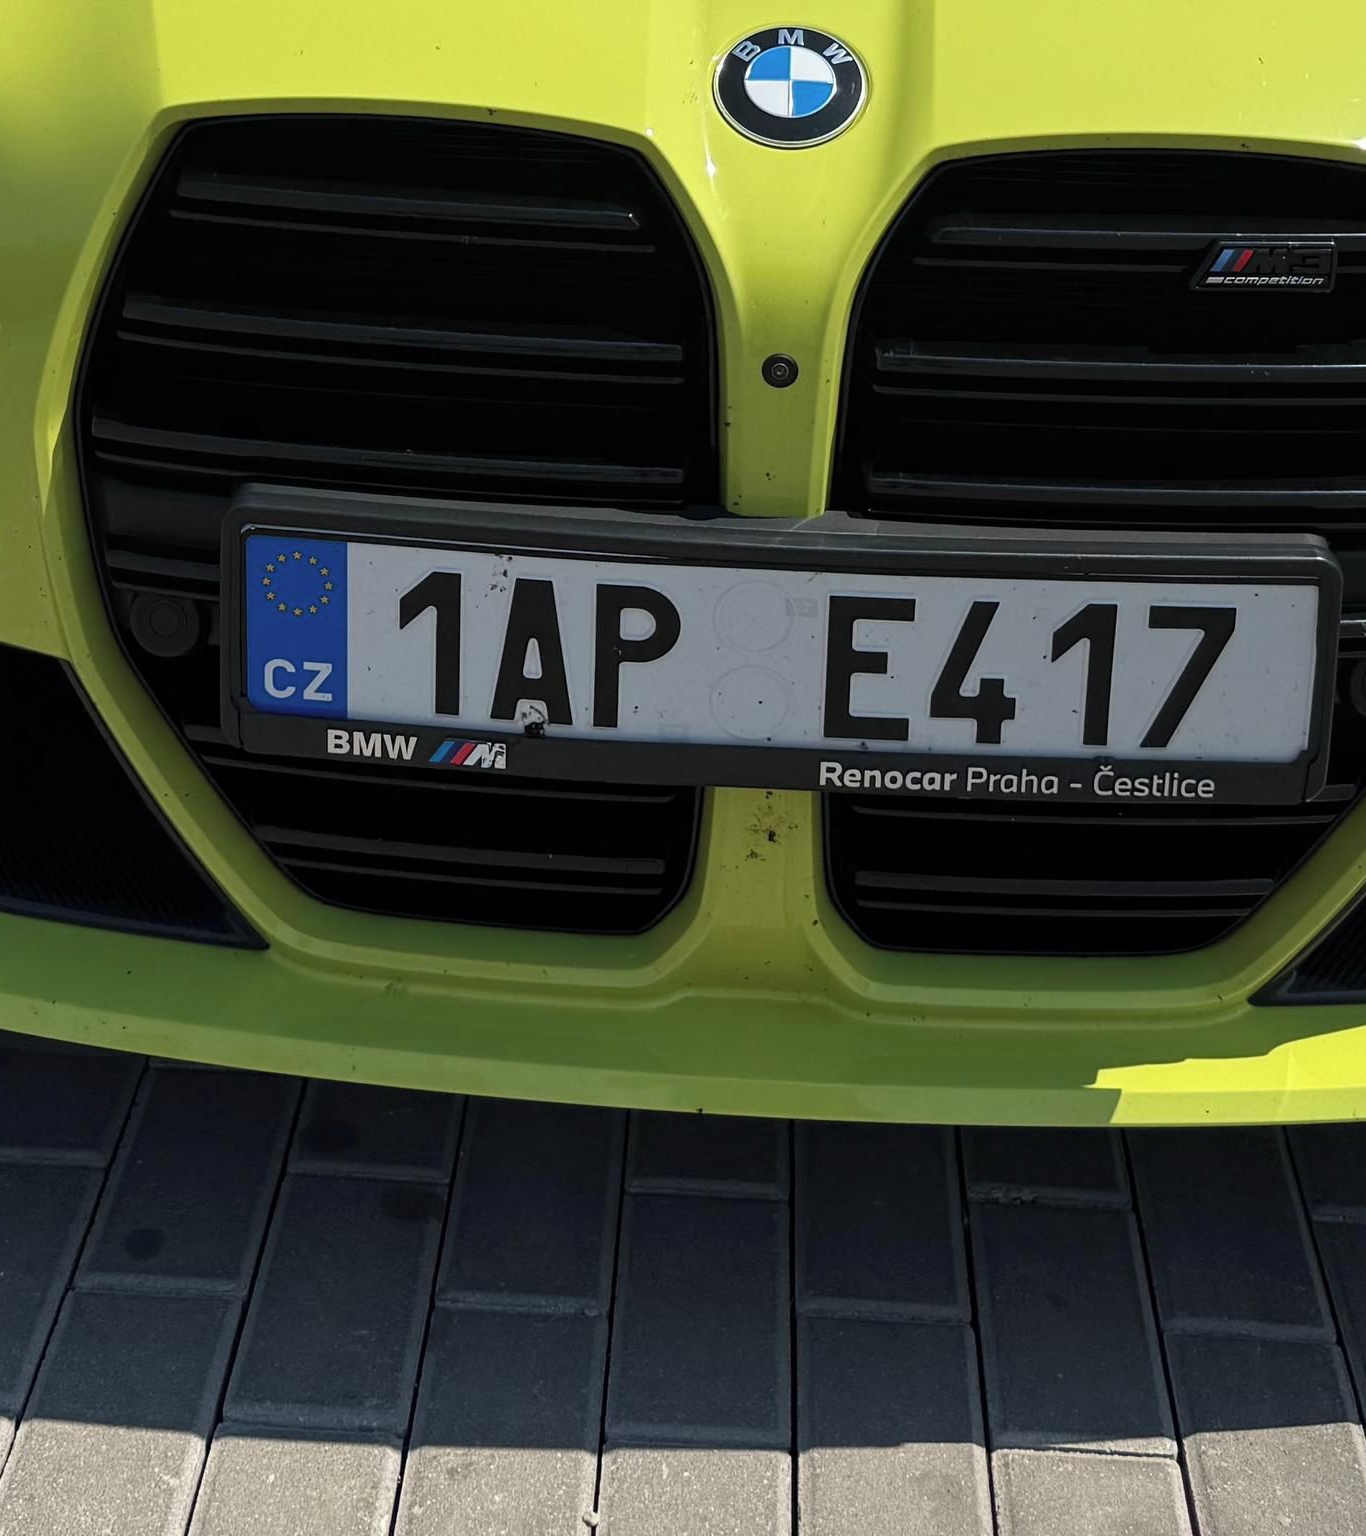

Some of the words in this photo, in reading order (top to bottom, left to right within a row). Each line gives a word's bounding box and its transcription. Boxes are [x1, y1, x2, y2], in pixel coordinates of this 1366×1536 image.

[731, 28, 854, 65] BMW
[1223, 275, 1325, 286] competition
[398, 570, 682, 729] 1AP
[822, 595, 1238, 749] E417
[263, 658, 334, 703] CZ
[326, 728, 418, 761] BMW
[818, 761, 958, 792] Renocar
[966, 767, 1060, 795] Praha
[1093, 764, 1216, 799] Čestlice
